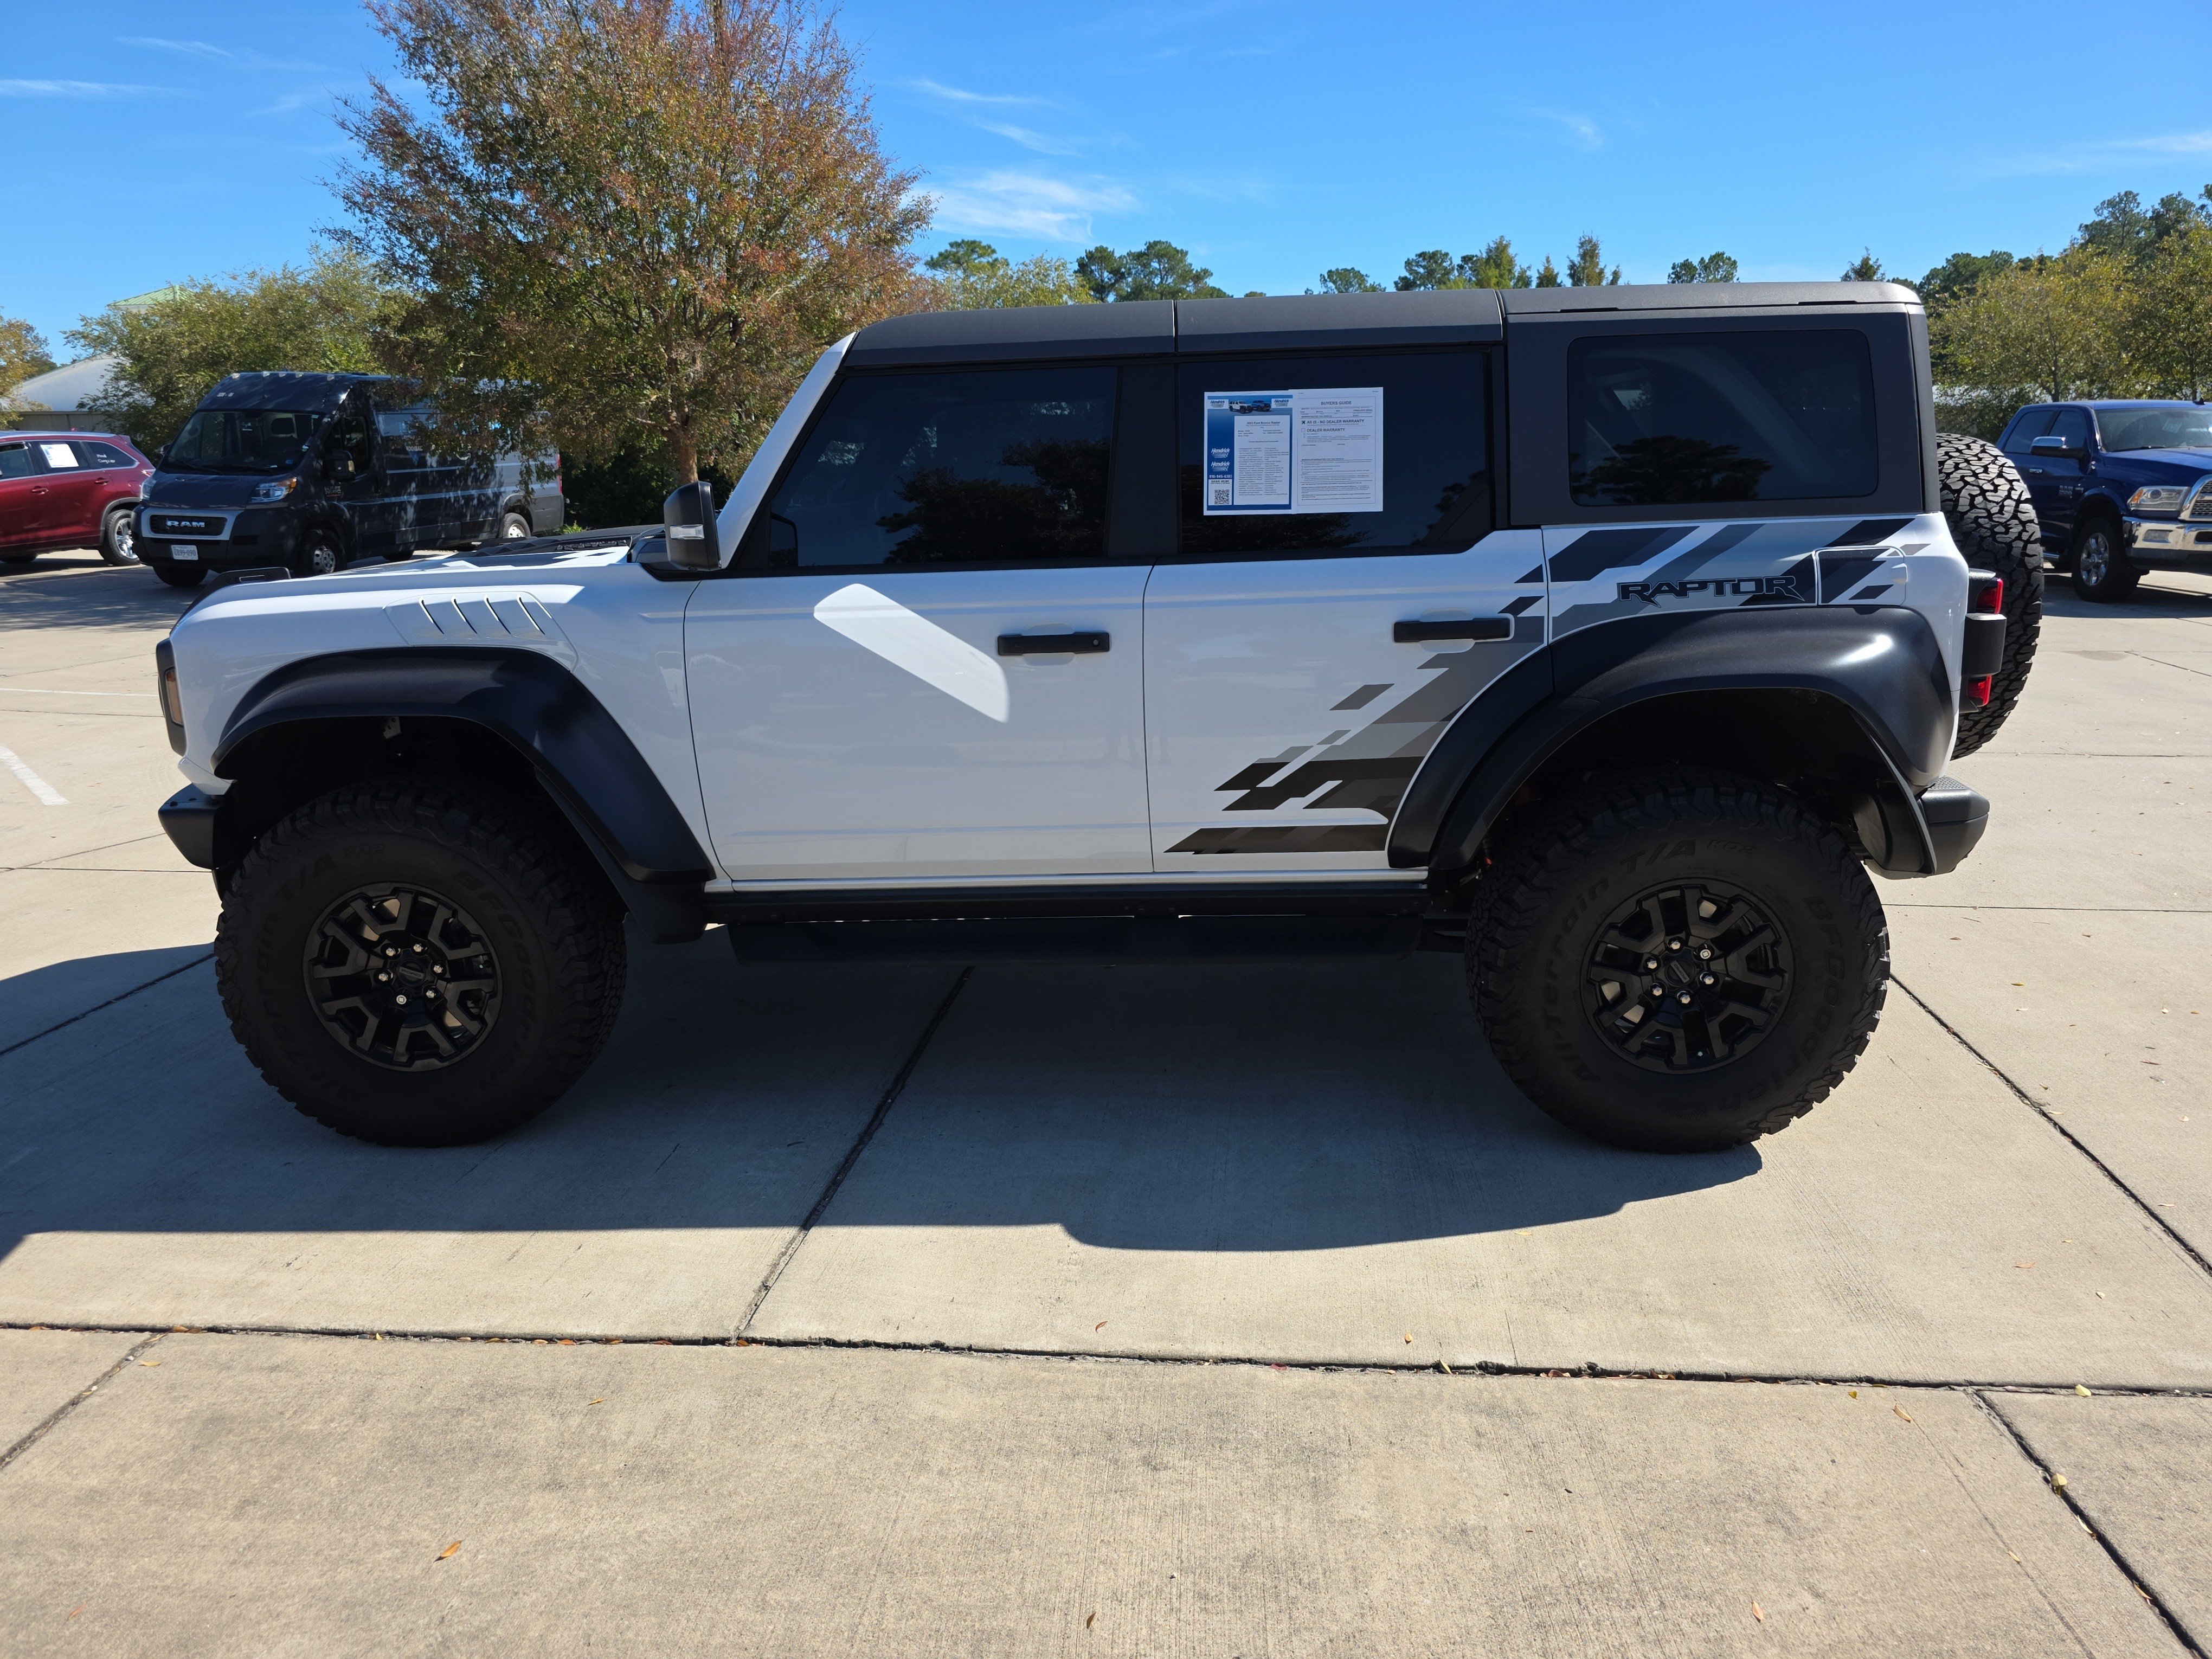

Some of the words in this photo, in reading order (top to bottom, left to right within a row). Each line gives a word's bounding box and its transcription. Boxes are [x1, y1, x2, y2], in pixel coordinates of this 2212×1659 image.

[1618, 576, 1805, 608] RAPTOR
[1621, 839, 1696, 874] T/A
[1707, 840, 1757, 854] KO2
